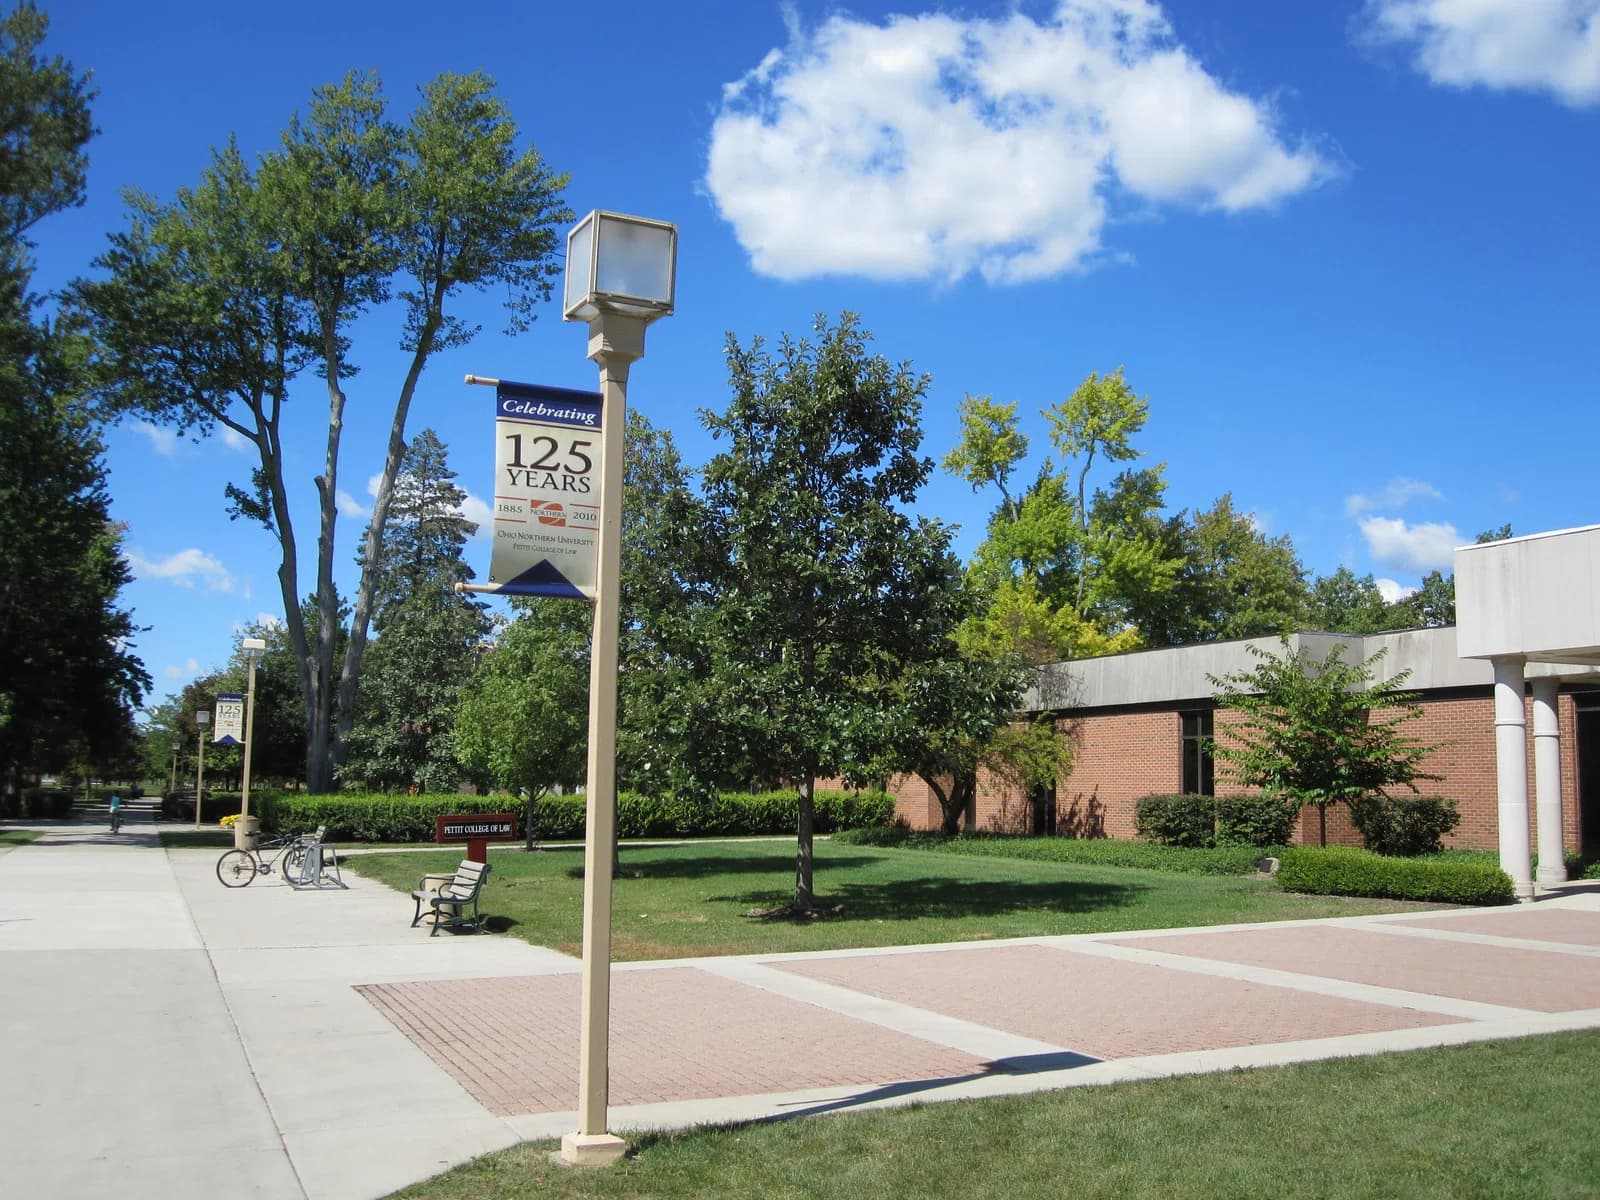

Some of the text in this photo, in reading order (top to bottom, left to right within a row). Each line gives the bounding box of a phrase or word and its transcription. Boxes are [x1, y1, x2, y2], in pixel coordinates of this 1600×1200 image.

[502, 399, 596, 425] Celebrating
[505, 433, 592, 474] 125
[506, 468, 591, 494] YEARS
[498, 504, 597, 521] 1885 NORTHERN 2010
[219, 705, 240, 715] 125
[444, 826, 464, 834] PETTIT
[465, 825, 489, 833] COLLEGE
